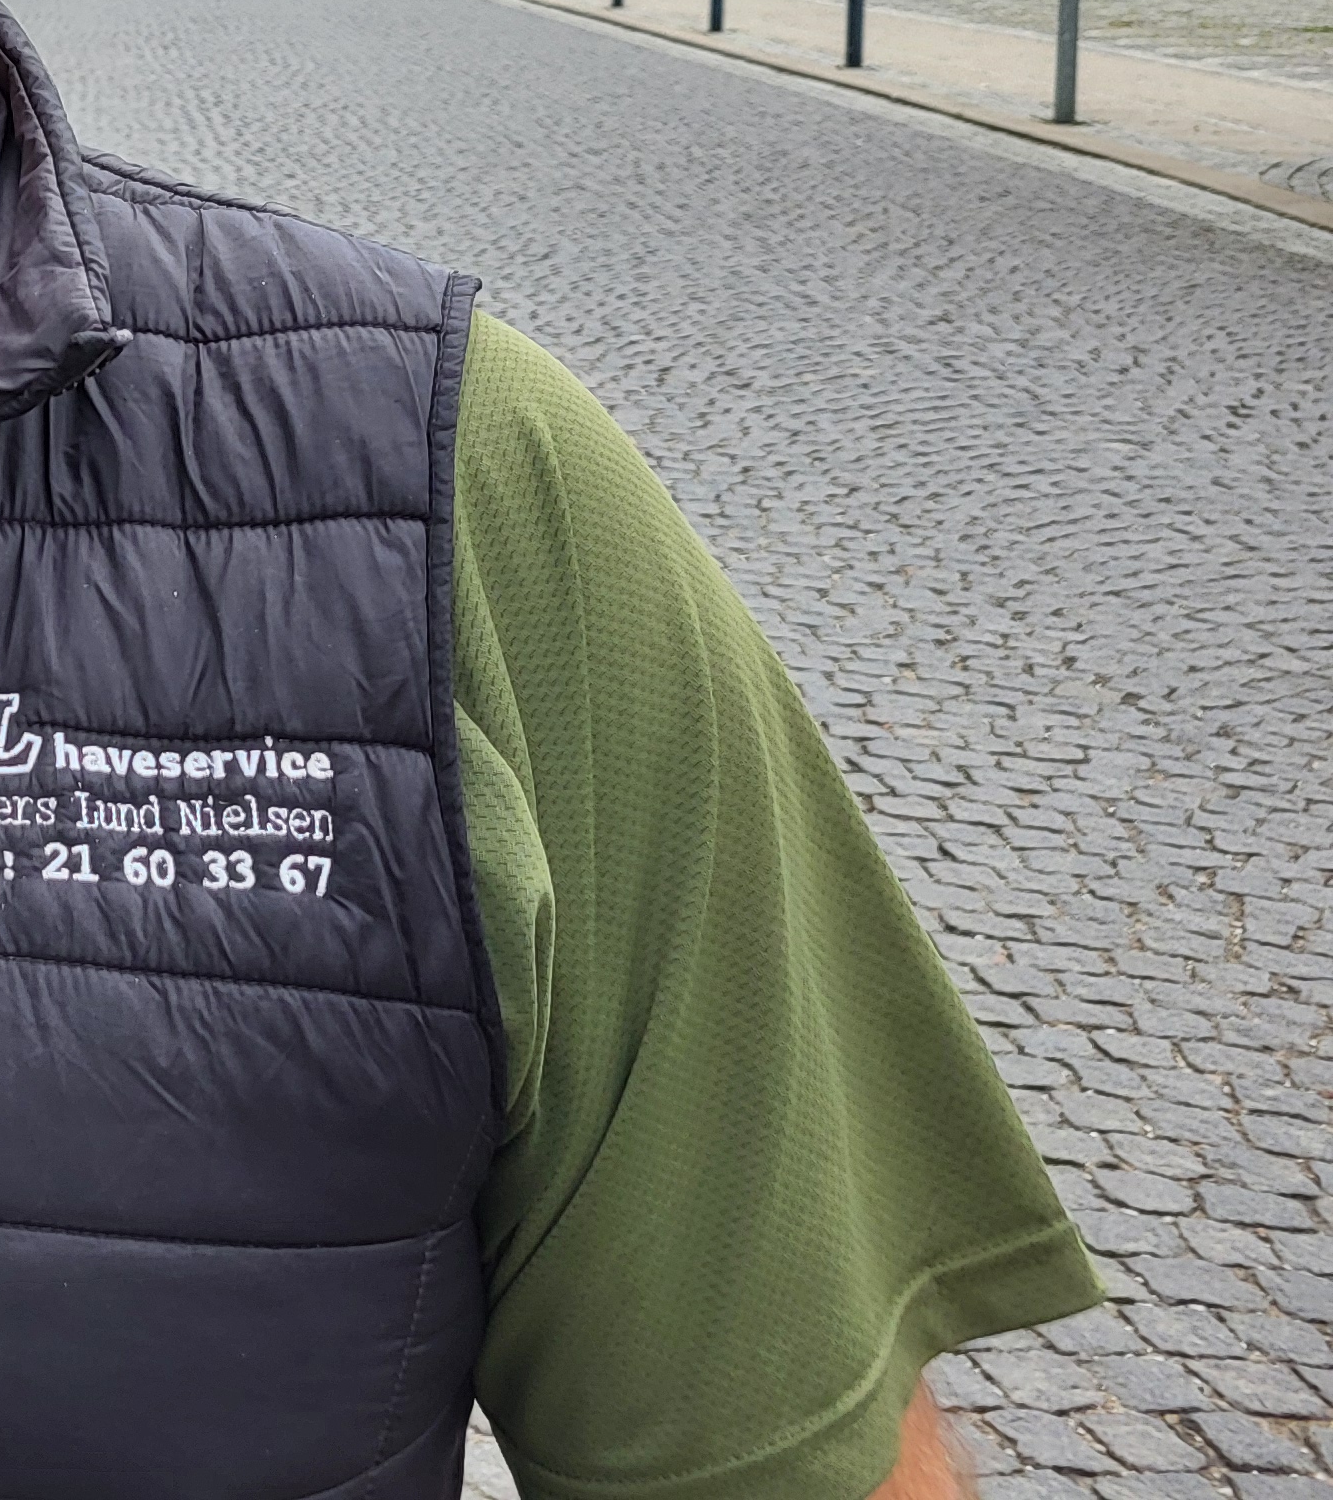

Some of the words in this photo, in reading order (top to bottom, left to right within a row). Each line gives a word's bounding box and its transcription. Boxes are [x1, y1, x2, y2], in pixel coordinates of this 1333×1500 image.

[52, 730, 334, 780] haveservice
[74, 788, 165, 837] Lund
[176, 794, 334, 842] Nielsen
[41, 841, 101, 883] 21
[122, 845, 177, 889] 60
[201, 849, 257, 891] 33
[278, 853, 333, 898] 67
